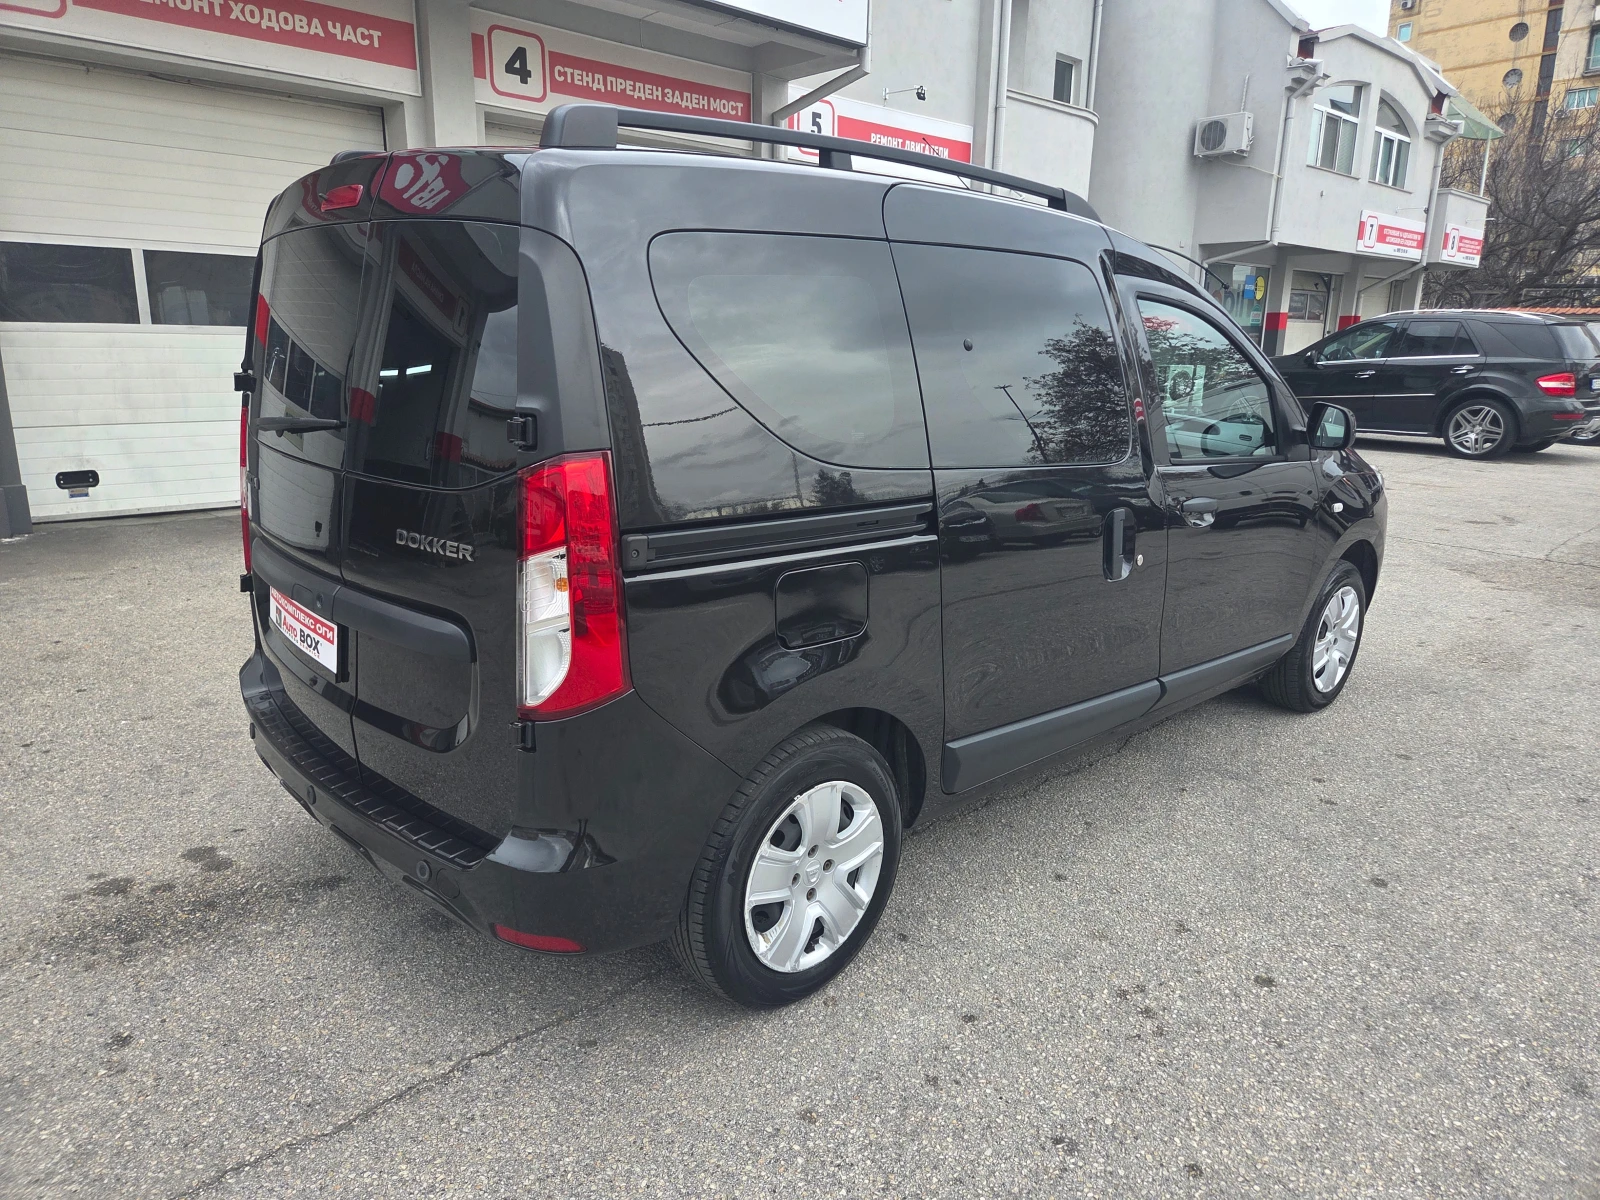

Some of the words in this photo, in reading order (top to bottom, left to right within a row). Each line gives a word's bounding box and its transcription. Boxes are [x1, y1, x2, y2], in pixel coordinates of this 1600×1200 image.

[228, 1, 324, 37] ХОДОВА
[327, 23, 382, 48] ЧАСТ
[505, 46, 532, 85] 4
[554, 65, 605, 93] СТЕНД
[607, 76, 662, 101] ПРЕДЕН
[664, 88, 708, 110] ЗАДЕН
[710, 97, 744, 116] МОСТ
[811, 111, 822, 134] 5
[871, 132, 903, 149] РЕМОНТ
[1368, 224, 1374, 240] 7
[396, 528, 474, 562] DOKKER
[300, 628, 320, 654] BOX
[316, 623, 333, 641] ОГИ
